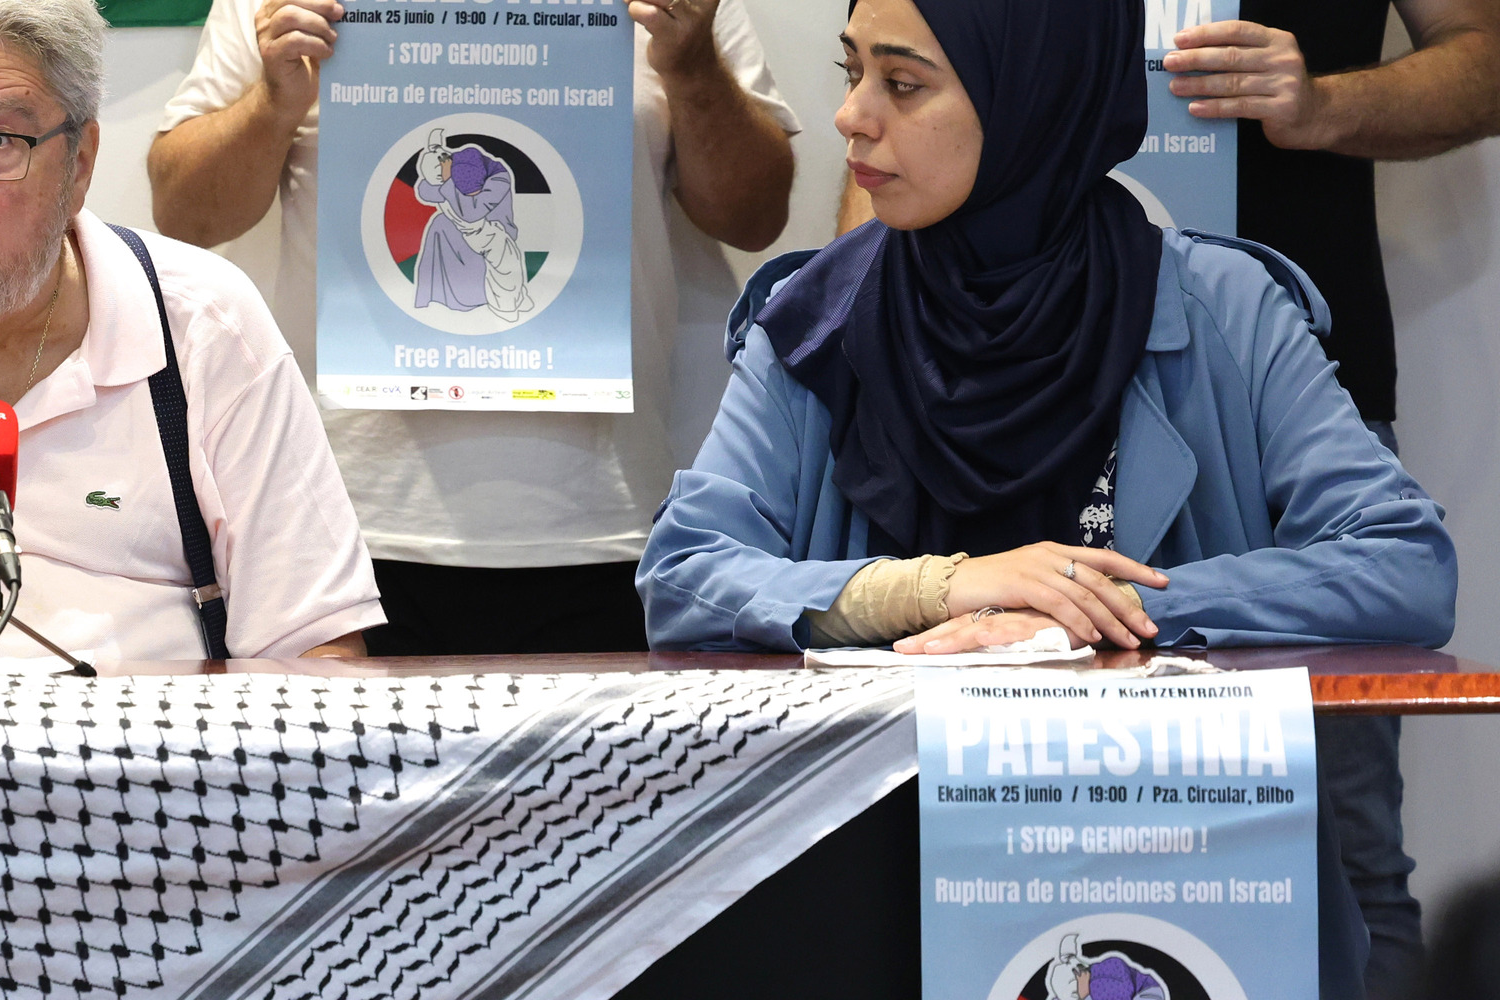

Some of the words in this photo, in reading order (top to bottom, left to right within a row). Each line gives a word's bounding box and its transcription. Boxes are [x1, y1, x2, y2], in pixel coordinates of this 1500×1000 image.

[338, 11, 382, 24] kainak
[386, 10, 400, 23] 25
[404, 11, 434, 25] junio
[442, 11, 447, 24] /
[455, 11, 486, 24] 19:00
[493, 12, 498, 25] /
[506, 13, 529, 26] Pza.
[534, 13, 584, 27] Circular,
[588, 14, 617, 26] Bilbo
[389, 43, 394, 64] ¡
[400, 43, 442, 64] STOP
[448, 43, 537, 66] GENOCIDIO
[543, 45, 548, 66] !
[331, 83, 398, 105] Ruptura
[403, 84, 424, 103] de
[430, 84, 522, 105] relaciones
[527, 89, 559, 105] con
[564, 86, 613, 106] Israel
[1138, 136, 1159, 153] on
[1165, 133, 1215, 153] Israel
[395, 345, 439, 368] Free
[445, 345, 541, 369] Palestine
[547, 347, 553, 369] !
[1101, 688, 1106, 697] /
[945, 710, 1287, 777] PALESTINA
[938, 786, 996, 802] Ekainak
[1001, 786, 1020, 801] 25
[1024, 785, 1062, 804] junio
[1072, 786, 1078, 802] /
[1088, 786, 1127, 802] 19:00
[1137, 786, 1143, 803] /
[1153, 786, 1182, 803] Pza.
[1187, 786, 1251, 805] Circular,
[1256, 787, 1293, 804] Bilbo
[1007, 829, 1013, 854] ¡
[1021, 826, 1074, 853] STOP
[1082, 827, 1193, 853] GENOCIDIO
[1201, 828, 1207, 853] !
[935, 878, 1019, 906] Ruptura
[1027, 878, 1053, 903] de
[1060, 877, 1175, 904] relaciones
[1182, 882, 1222, 903] con
[1230, 878, 1292, 903] Israel
